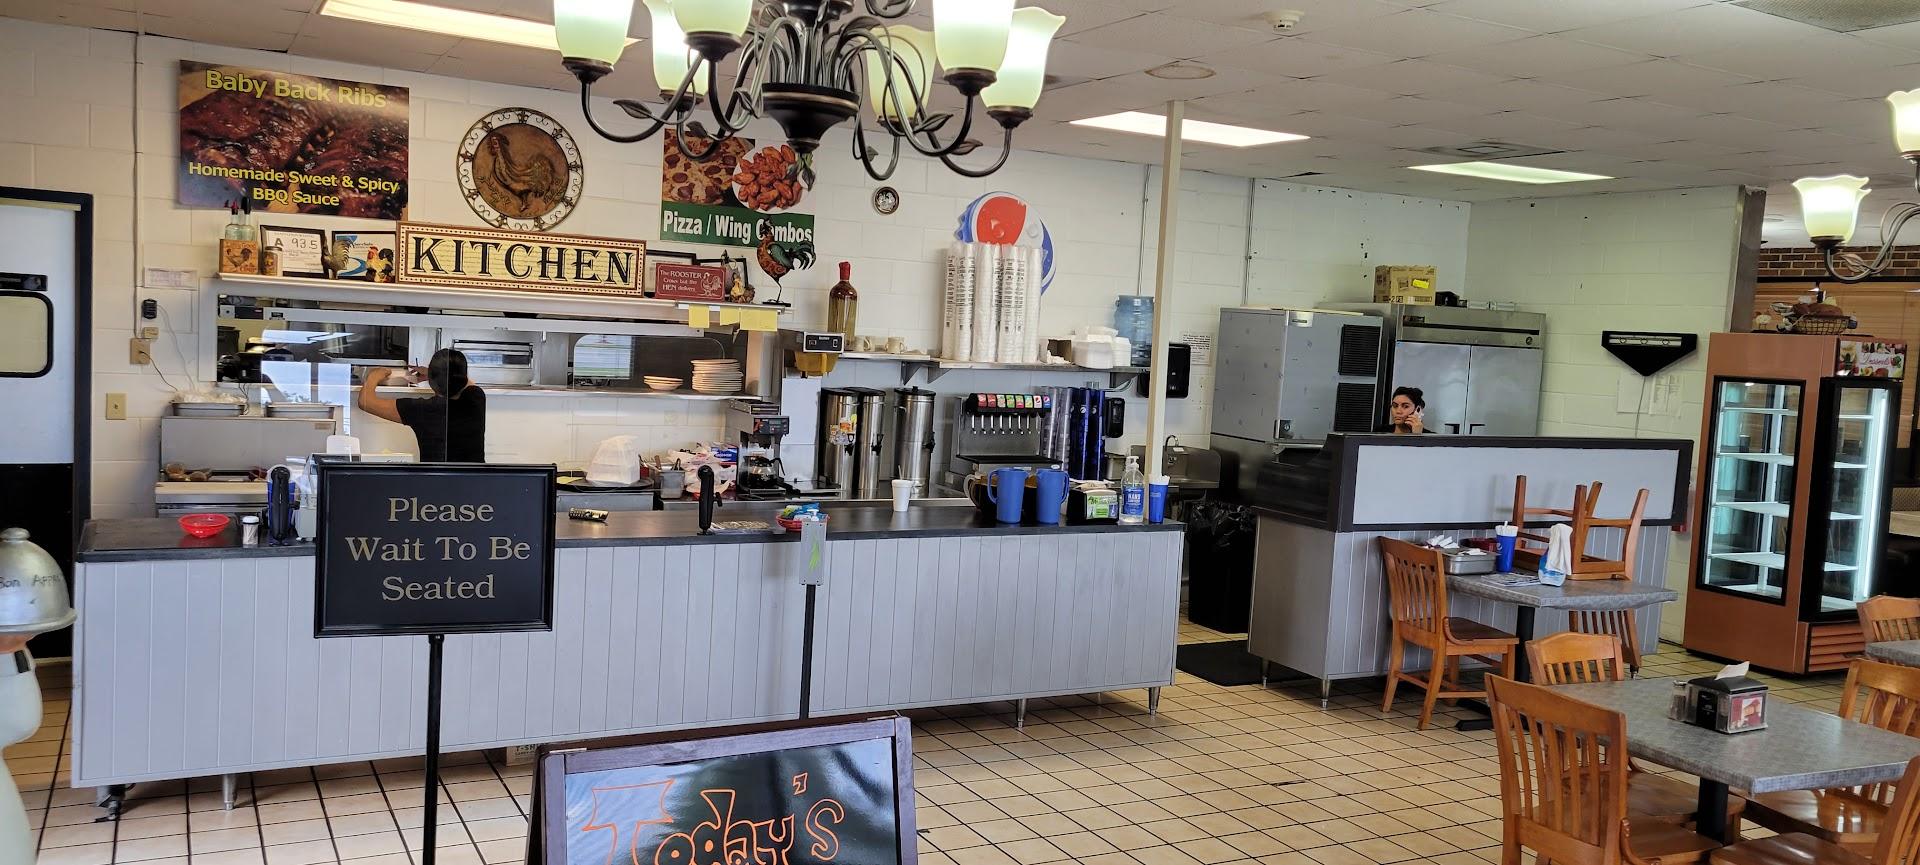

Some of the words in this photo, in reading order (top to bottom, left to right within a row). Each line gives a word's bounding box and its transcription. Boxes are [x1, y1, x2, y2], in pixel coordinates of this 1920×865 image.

[206, 70, 267, 98] Baby
[274, 79, 331, 101] Back
[338, 86, 387, 108] Ribs
[189, 162, 285, 182] Homemade
[288, 171, 338, 187] Sweet
[342, 176, 354, 188] &
[358, 178, 400, 193] Spicy
[253, 188, 289, 203] BBQ
[292, 191, 340, 206] Sauce
[663, 210, 703, 235] Pizza
[706, 213, 712, 236] /
[715, 214, 752, 244] Wing
[274, 237, 284, 247] A
[291, 238, 318, 250] 93.5
[411, 236, 634, 285] KITCHEN
[670, 271, 702, 279] ROOSTER
[387, 496, 495, 522] Please
[345, 536, 426, 561] Wait
[434, 536, 477, 561] To
[488, 536, 531, 560] Be
[381, 573, 496, 601] Seated
